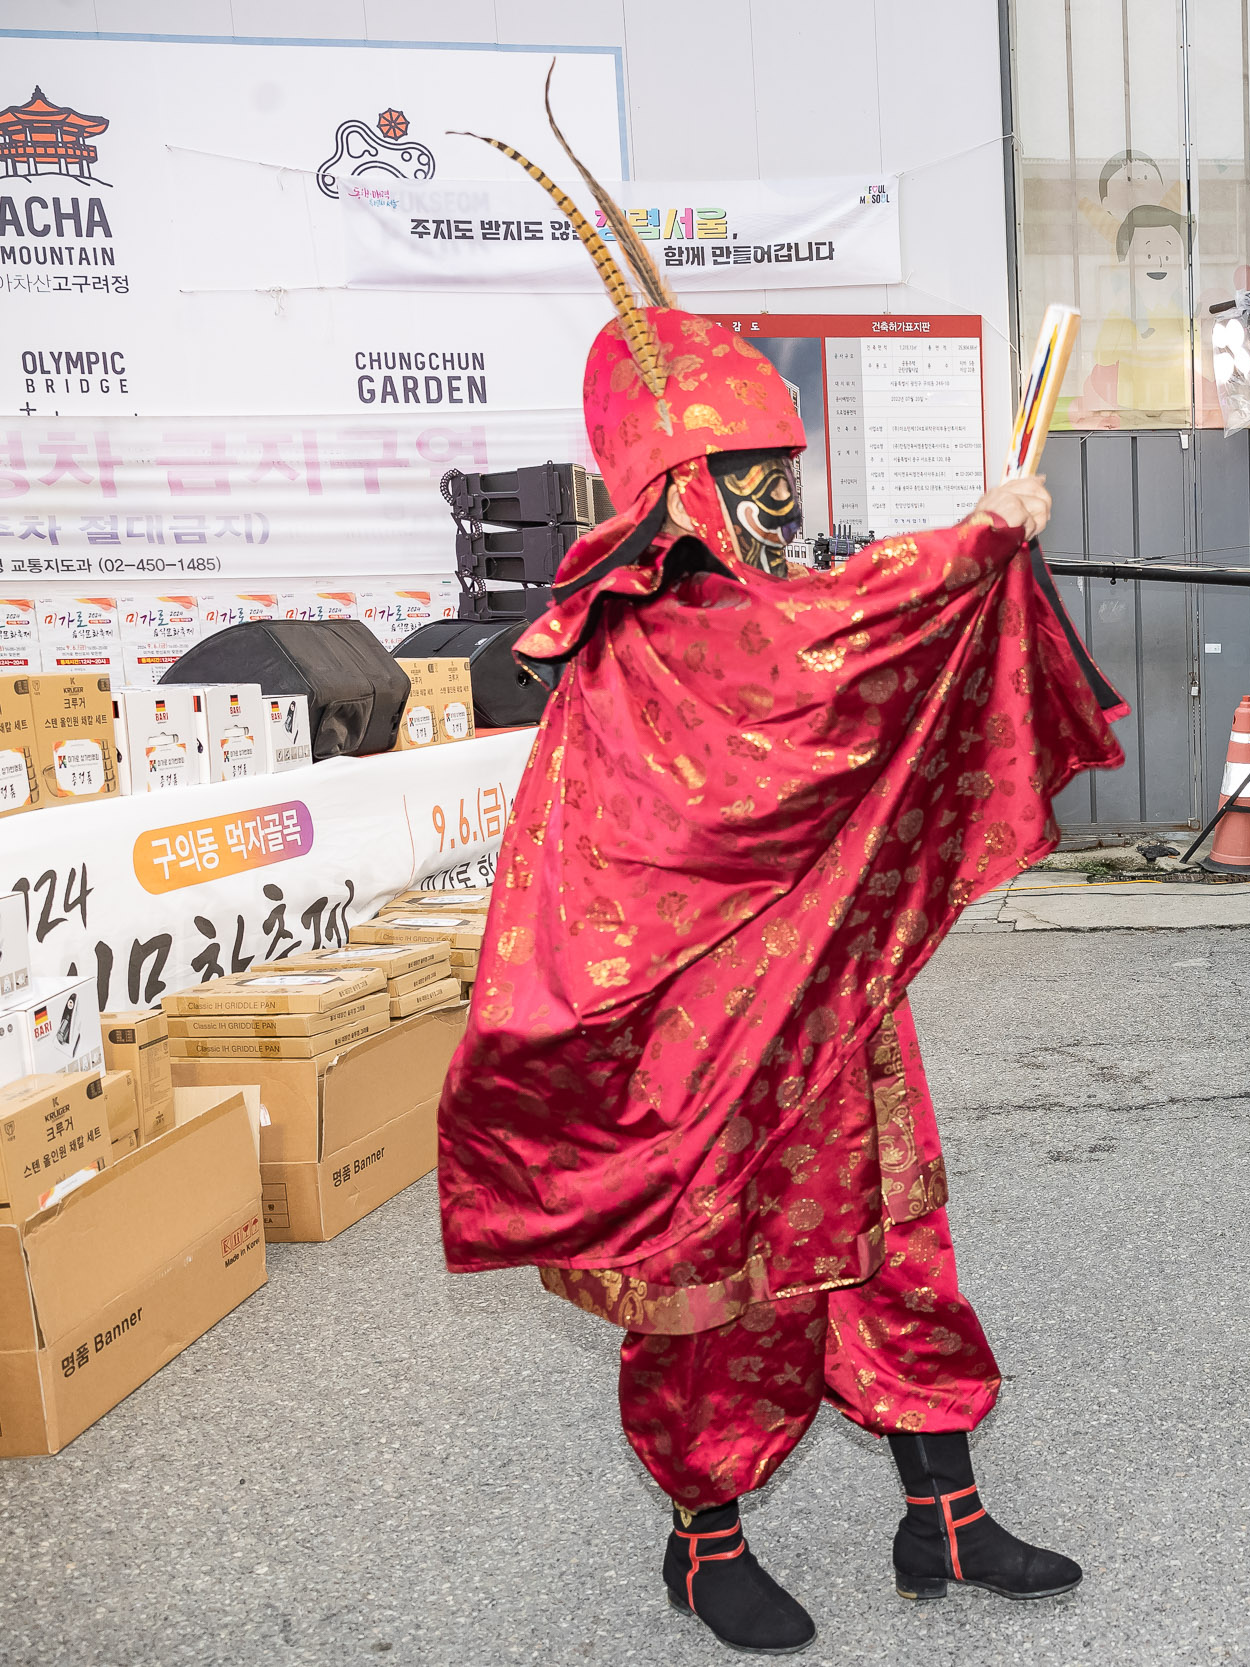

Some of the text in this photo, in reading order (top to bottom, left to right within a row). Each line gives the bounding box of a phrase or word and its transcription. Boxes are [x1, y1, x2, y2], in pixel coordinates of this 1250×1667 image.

[410, 218, 475, 241] 주지도
[480, 219, 544, 241] 받지도
[1, 245, 116, 266] MOUNTAIN
[664, 240, 835, 267] 함께 만들어갑니다
[871, 321, 931, 333] 건축허가표지판
[21, 351, 126, 375] OLYMPIC
[355, 352, 485, 370] CHUNGCHUN
[25, 378, 128, 393] BRIDGE
[357, 375, 487, 404] GARDEN
[11, 556, 221, 574] 교통지도과 (02-450-1485)
[44, 611, 87, 628] 미가로
[126, 609, 169, 627] 미가로
[364, 605, 406, 622] 미가로
[64, 697, 86, 709] 크루거
[155, 712, 169, 722] BARI
[151, 809, 302, 880] 구의동 먹자골목
[188, 1001, 276, 1011] Classic IH GRIDDLE PAN
[34, 1020, 52, 1039] BARI
[193, 1021, 276, 1030] Classic IH GRIDDLE PAN
[196, 1044, 280, 1053] Classic IH GRIDDLE PAN
[46, 1116, 74, 1142] 크루거
[23, 1159, 41, 1179] 스텐
[42, 1144, 67, 1168] 올인원
[86, 1126, 102, 1142] 세트
[332, 1147, 385, 1187] 명품 Banner
[61, 1307, 143, 1378] 명품 Banner
